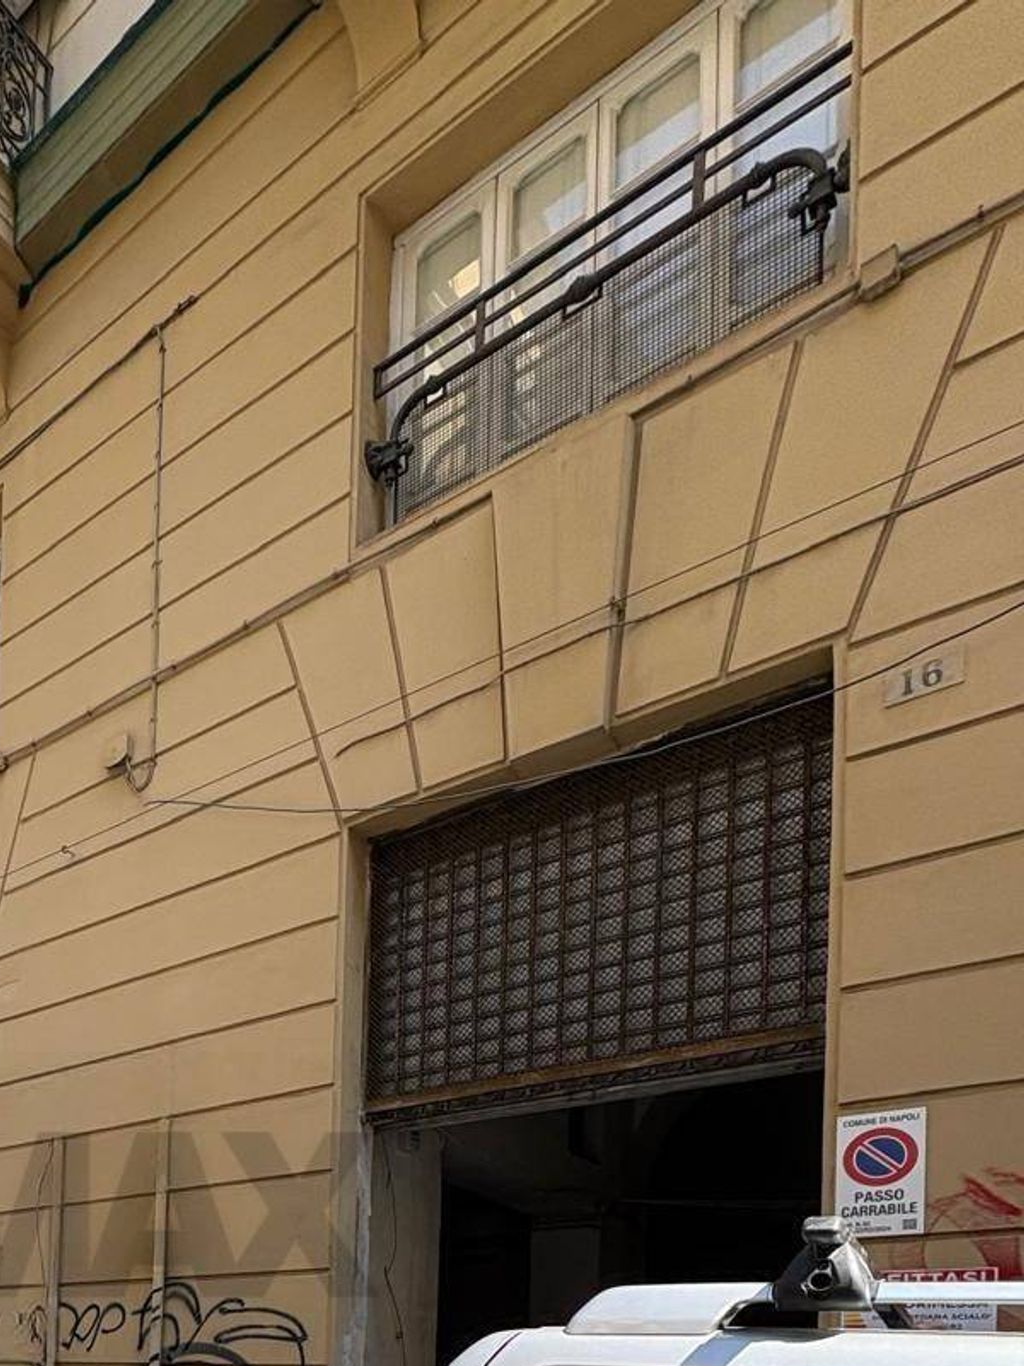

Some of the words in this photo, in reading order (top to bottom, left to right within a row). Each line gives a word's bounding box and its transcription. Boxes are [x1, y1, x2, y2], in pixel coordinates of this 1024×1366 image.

[902, 659, 943, 696] 16
[843, 1117, 877, 1129] COMUNE
[879, 1115, 888, 1124] DI
[889, 1112, 921, 1123] NAPOLI
[854, 1188, 905, 1204] PASSO
[841, 1201, 918, 1219] CARRABILE
